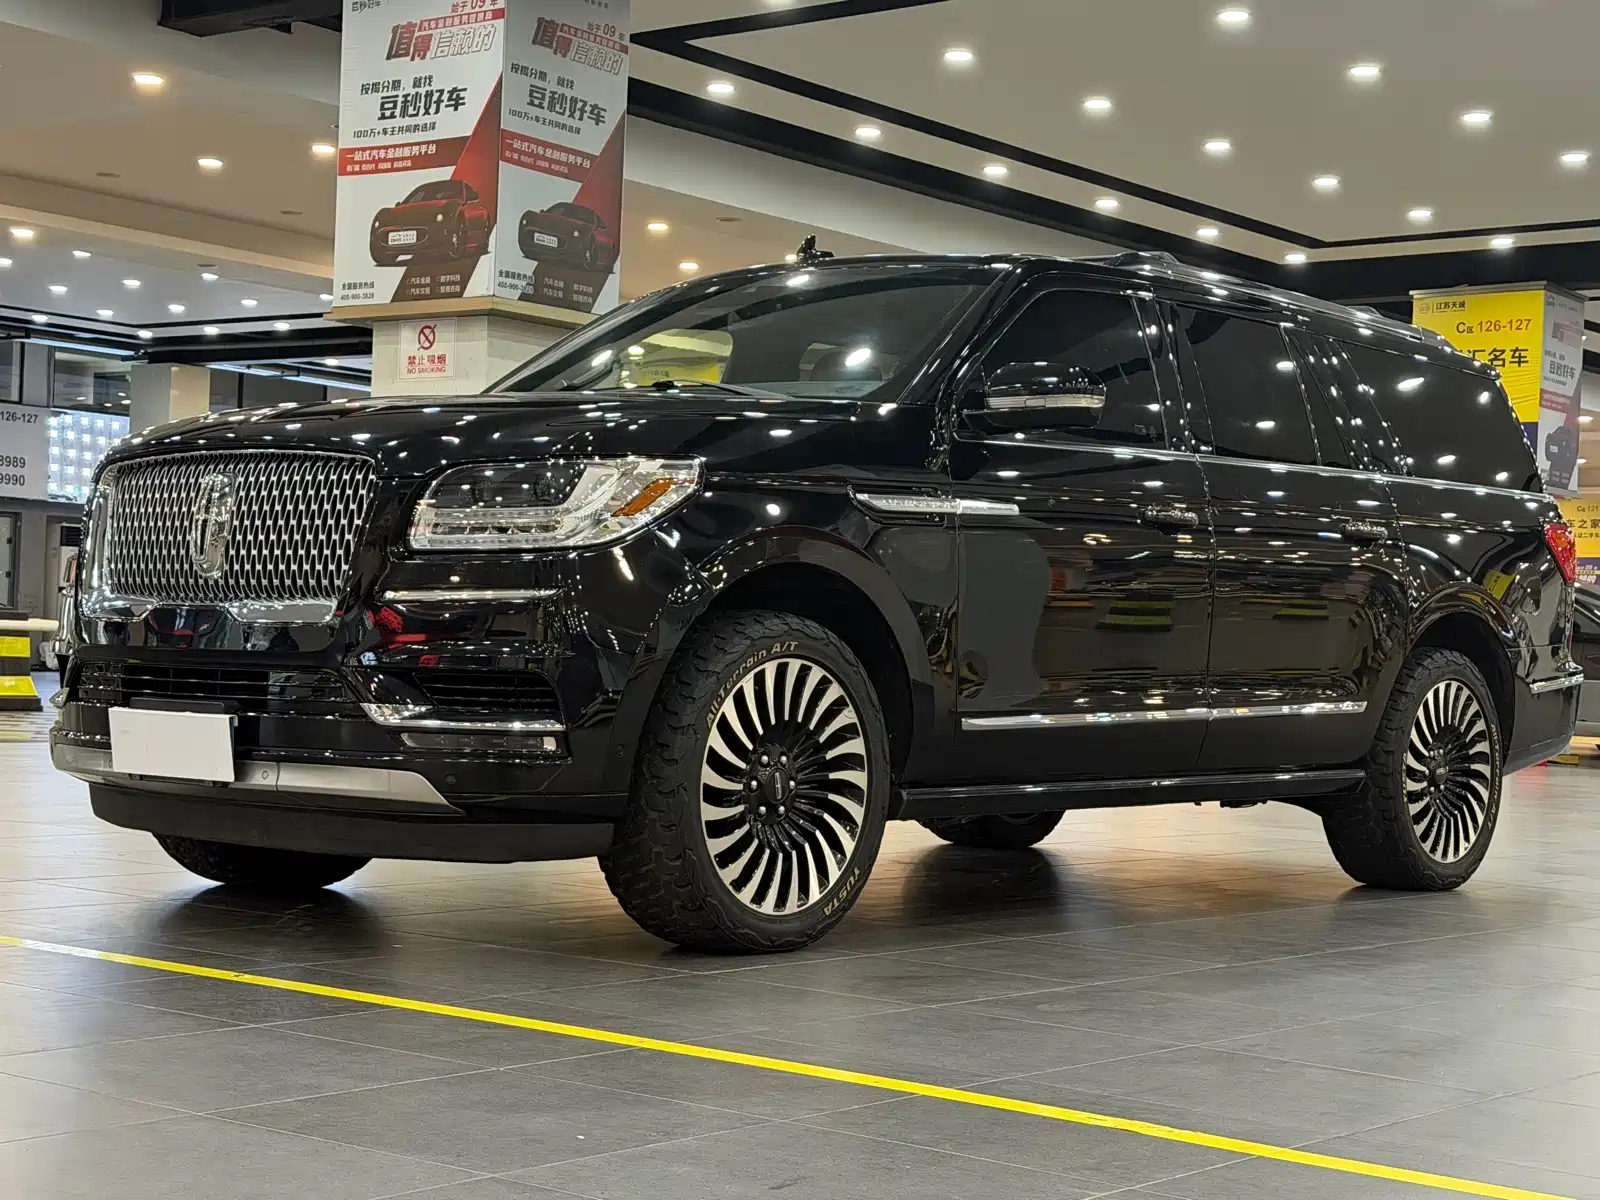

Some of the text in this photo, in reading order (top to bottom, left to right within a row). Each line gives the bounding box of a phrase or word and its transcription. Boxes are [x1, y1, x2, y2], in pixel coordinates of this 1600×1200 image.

[603, 23, 616, 37] 09
[386, 21, 496, 61] 值得信赖的
[531, 17, 623, 76] 值得信赖的
[377, 86, 468, 121] 豆秒好车
[526, 83, 607, 126] 豆秒好车
[353, 121, 436, 138] 100万+车主共同的选择
[346, 143, 436, 161] 一站式汽车金融服务平台
[505, 139, 591, 169] 一站式汽车金融服务平台
[1478, 318, 1532, 333] 126-127
[407, 353, 447, 367] 禁止吸烟
[407, 366, 446, 375] NO SMOKING
[0, 411, 38, 424] 126-127
[707, 641, 799, 729] All-Terrain A/T
